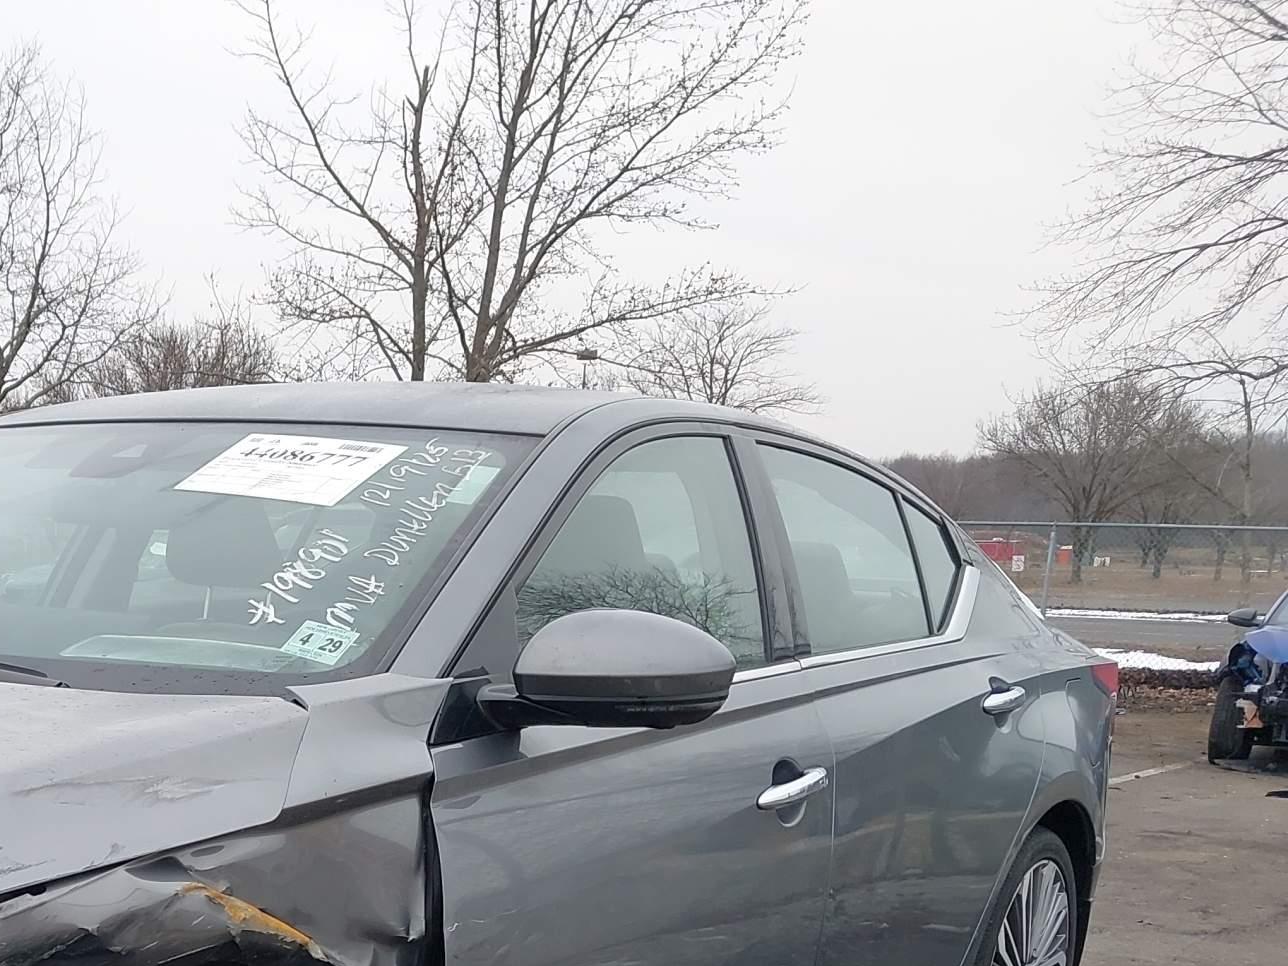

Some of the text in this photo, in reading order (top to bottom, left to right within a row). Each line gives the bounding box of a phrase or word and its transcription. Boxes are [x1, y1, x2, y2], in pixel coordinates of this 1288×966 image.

[239, 446, 369, 467] 44086777
[298, 632, 314, 646] 4
[317, 637, 344, 653] 29
